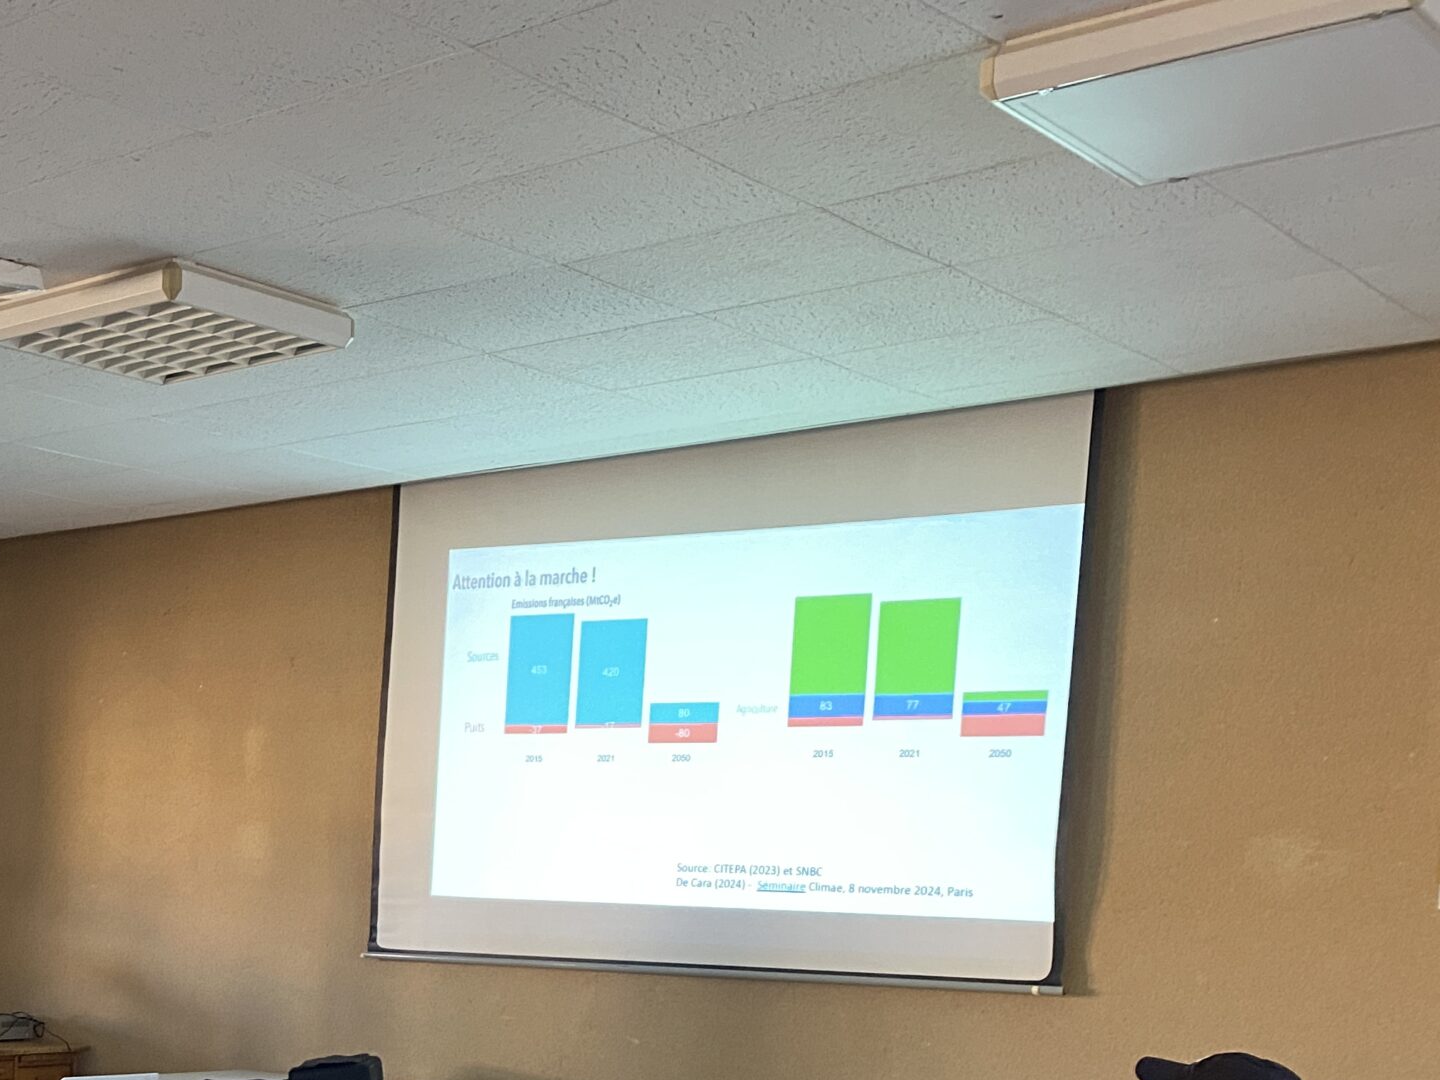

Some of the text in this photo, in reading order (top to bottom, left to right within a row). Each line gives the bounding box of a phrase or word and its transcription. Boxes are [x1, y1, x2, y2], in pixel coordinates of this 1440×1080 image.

[452, 566, 597, 590] Attention à la marche !
[511, 598, 548, 609] Emissions
[548, 596, 585, 609] françaises
[906, 700, 920, 710] 77
[997, 702, 1012, 713] 47
[677, 708, 690, 719] 80
[672, 754, 691, 763] 2050
[813, 749, 834, 758] 2015
[899, 749, 921, 758] 2021
[989, 749, 1012, 759] 2050
[525, 755, 543, 763] 2015
[597, 755, 615, 763] 2021
[713, 864, 747, 874] CITEPA
[749, 865, 780, 876] (2023)
[783, 867, 793, 876] et
[795, 866, 823, 877] SNBC
[675, 877, 689, 887] De
[690, 878, 712, 888] Cara
[714, 879, 746, 890] (2024)
[848, 883, 855, 893] 8
[858, 884, 911, 895] novembre
[913, 885, 944, 897] 2024,
[947, 886, 973, 897] Paris
